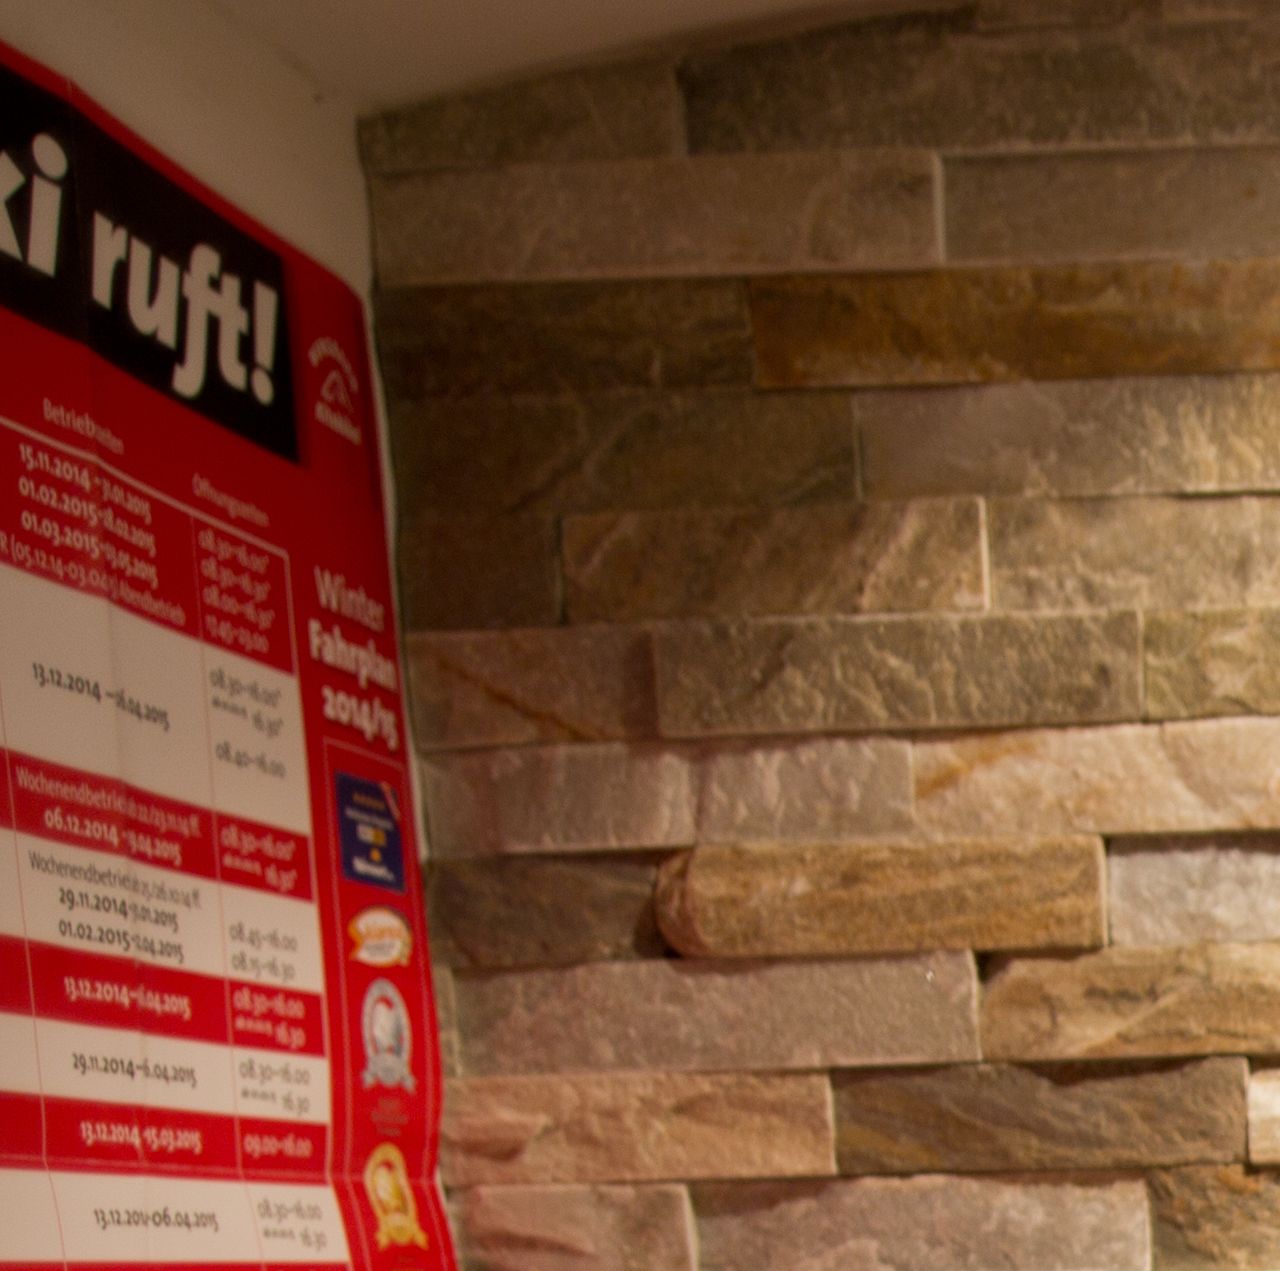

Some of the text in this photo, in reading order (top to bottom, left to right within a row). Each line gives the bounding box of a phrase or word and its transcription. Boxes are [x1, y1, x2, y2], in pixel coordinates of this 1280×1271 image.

[92, 210, 280, 407] ruft!
[311, 565, 386, 632] Winter
[305, 618, 399, 692] Fahrplan
[319, 684, 401, 751] 2014/15
